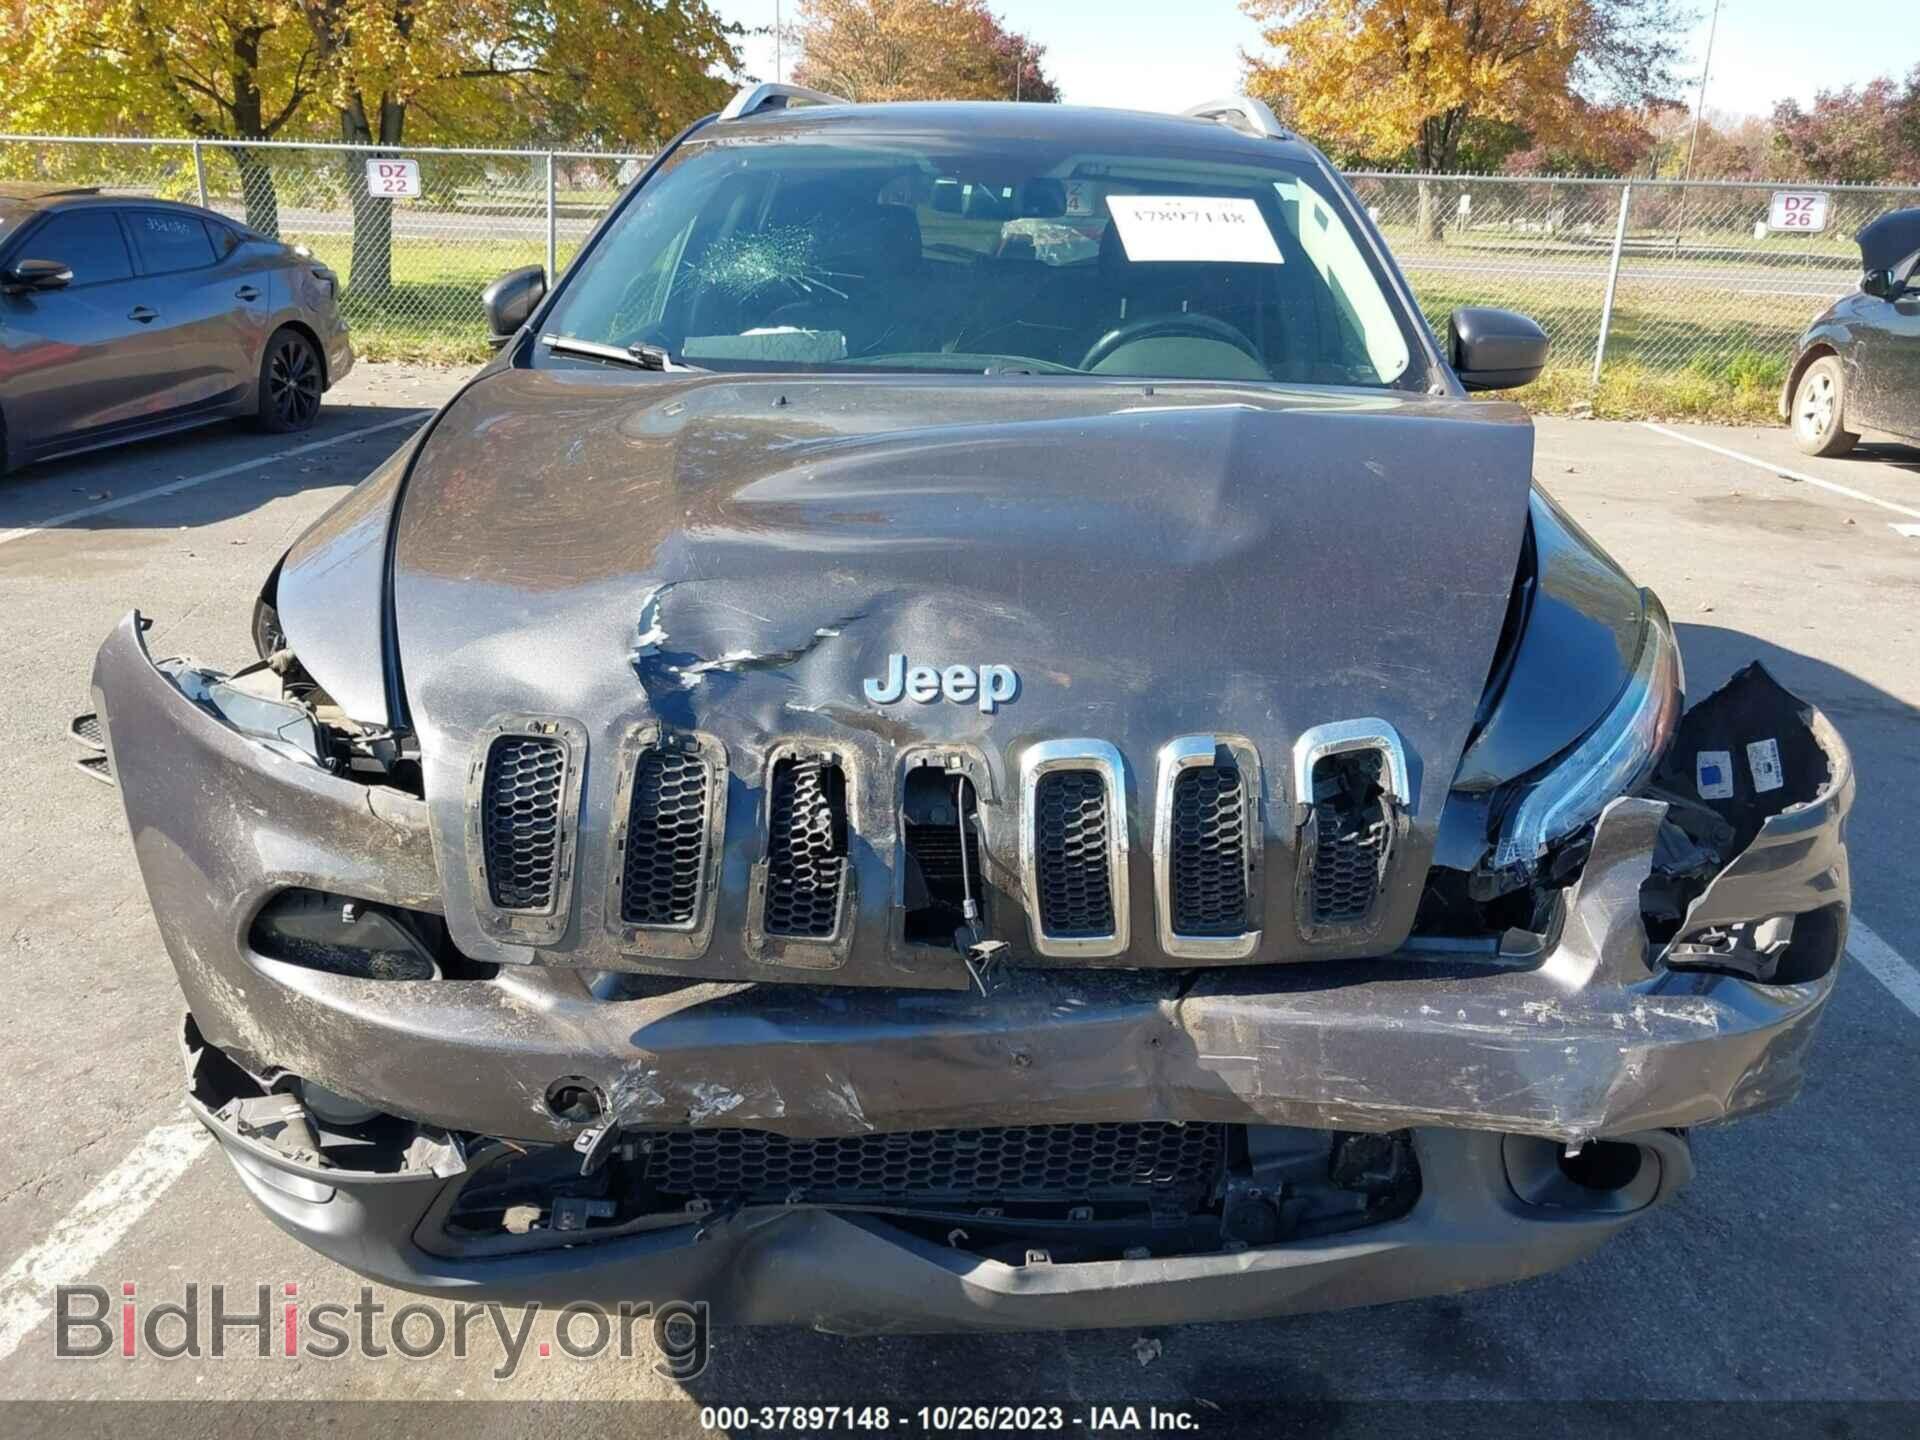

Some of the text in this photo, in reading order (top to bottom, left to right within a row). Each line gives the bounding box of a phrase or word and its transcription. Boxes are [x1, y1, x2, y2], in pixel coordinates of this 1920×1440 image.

[379, 164, 407, 178] DZ
[383, 179, 408, 193] 22
[1785, 196, 1816, 211] DZ
[1784, 212, 1811, 226] 26
[863, 653, 1018, 713] Jeep
